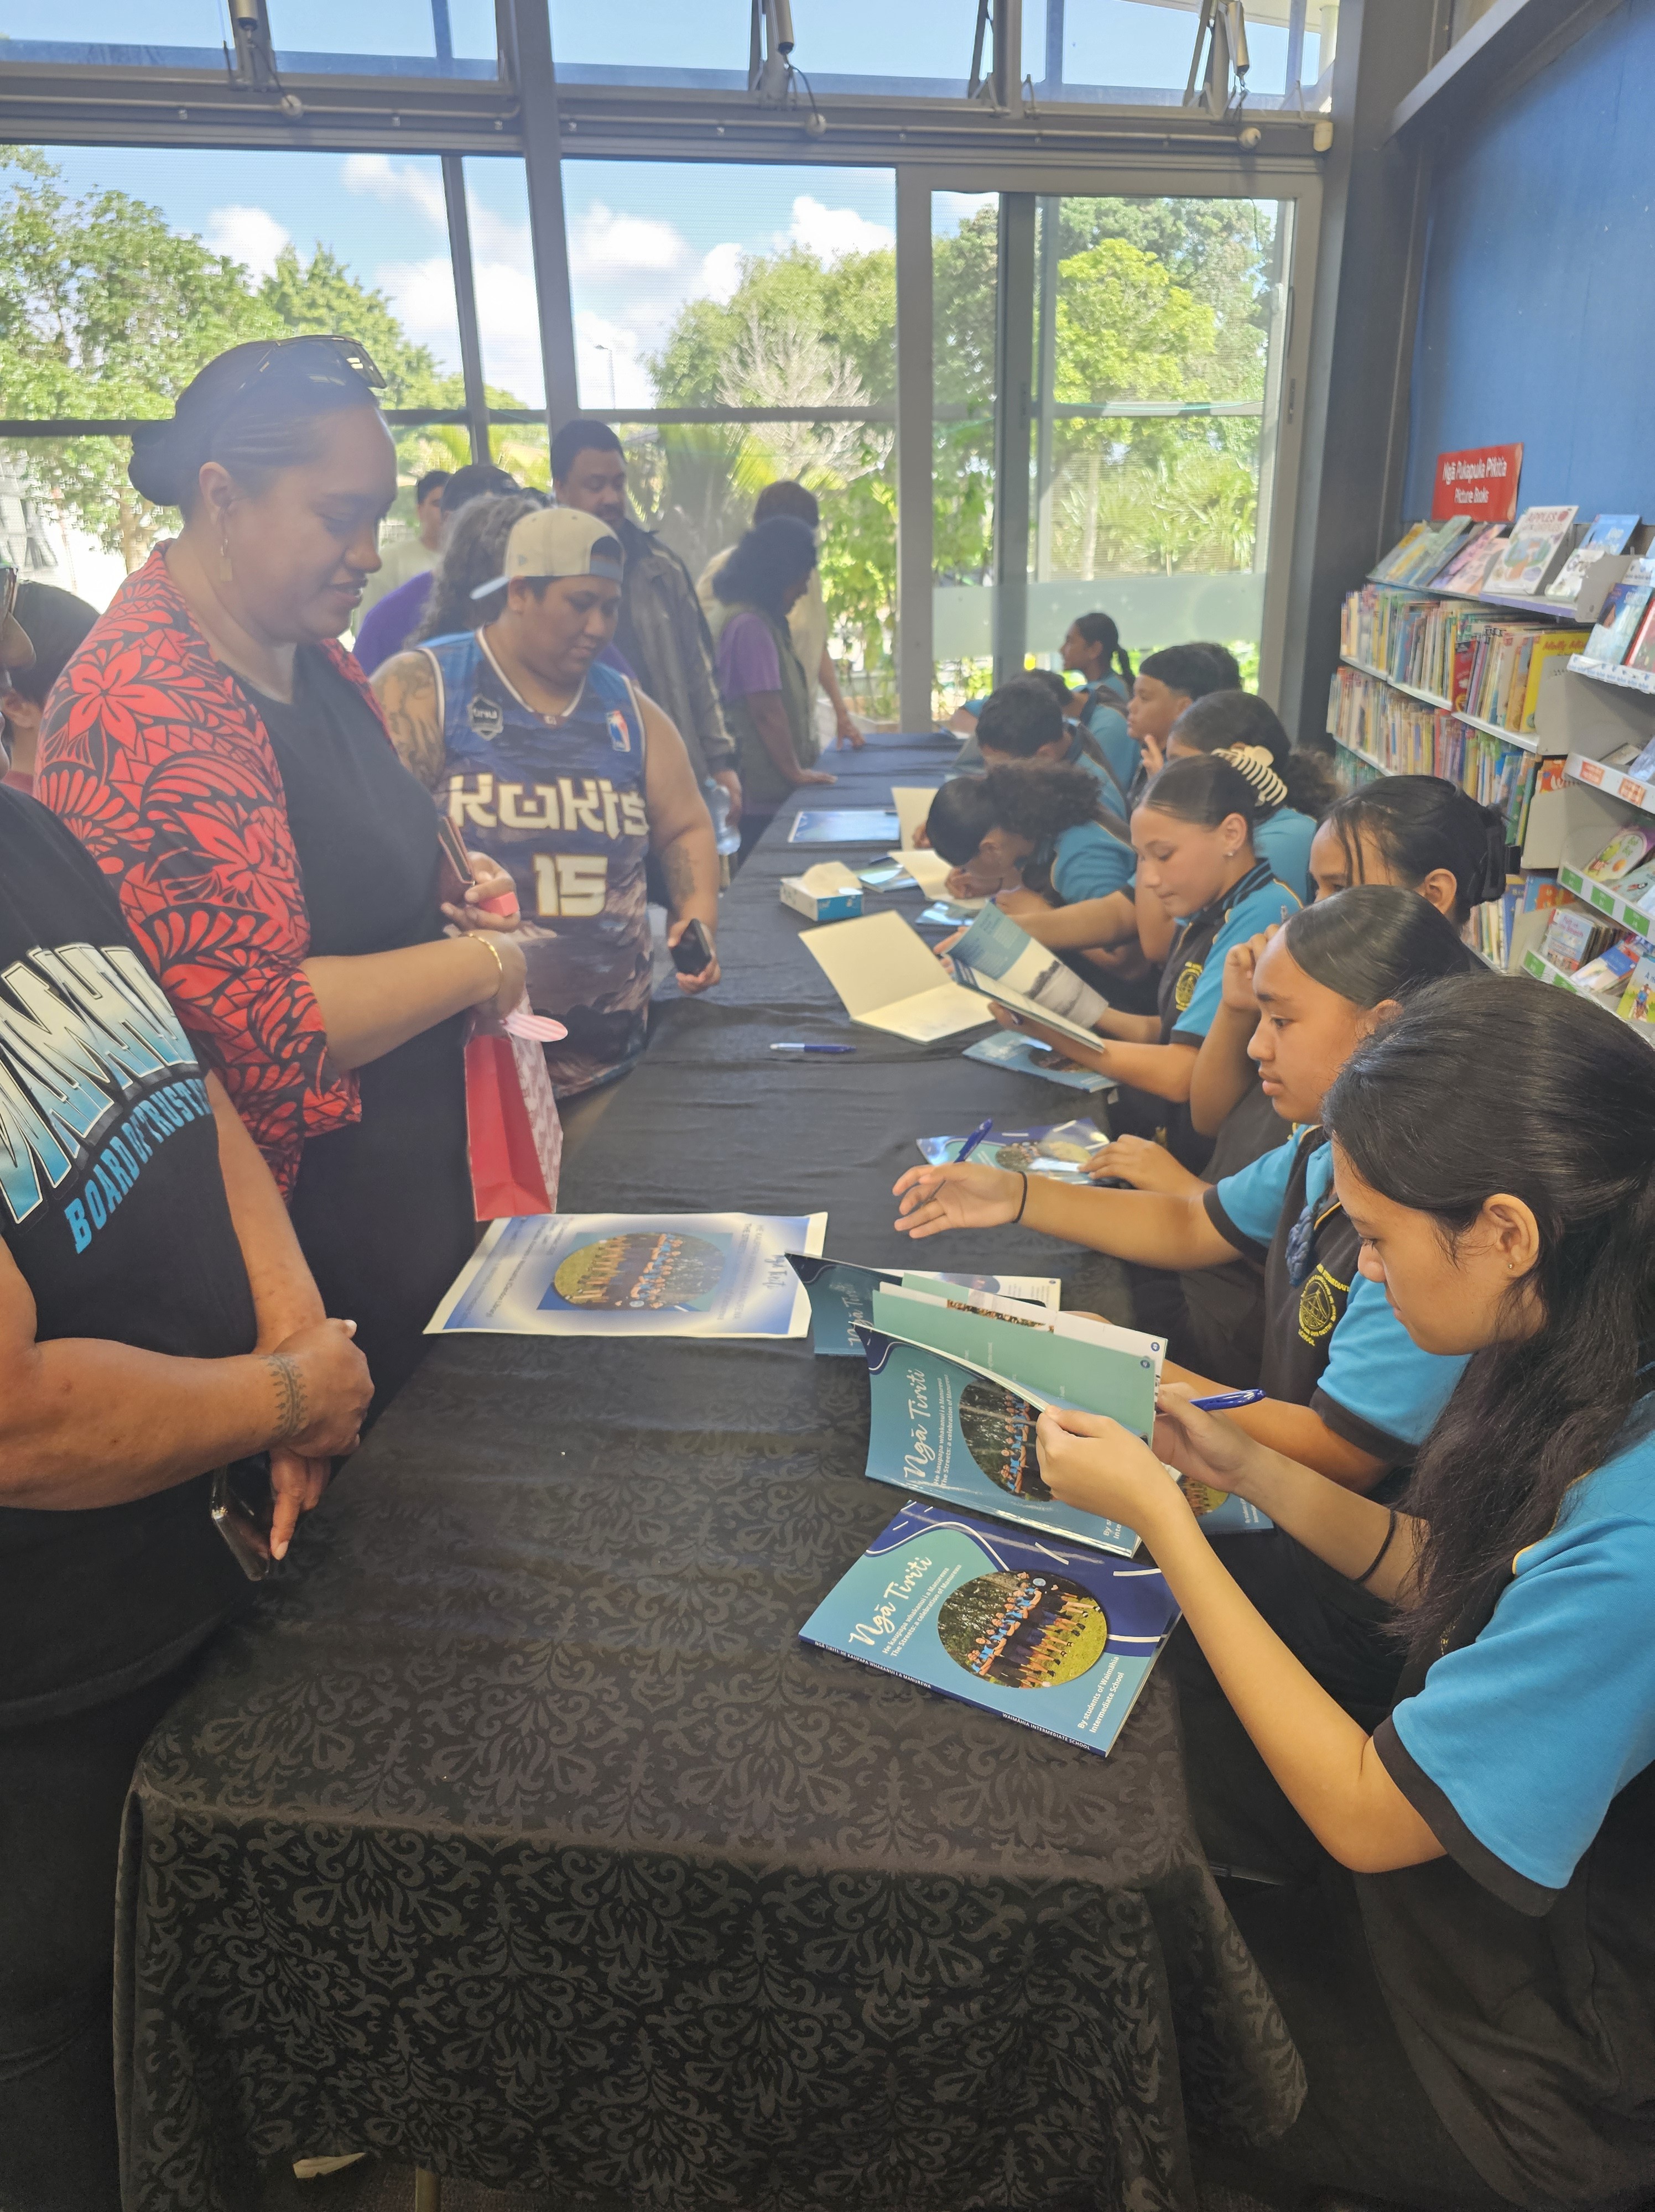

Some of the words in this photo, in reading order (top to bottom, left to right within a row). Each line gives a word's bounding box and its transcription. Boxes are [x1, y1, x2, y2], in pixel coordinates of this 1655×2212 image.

[1454, 487, 1474, 503] Picture
[1474, 486, 1489, 503] Books
[534, 854, 607, 916] 15
[64, 1135, 140, 1254] BOARD
[123, 1115, 153, 1164] OF
[907, 1369, 931, 1420] Tiriti
[903, 1423, 935, 1478] Ngā
[934, 1444, 944, 1474] kaupapa
[943, 1447, 951, 1474] Streets:
[934, 1475, 940, 1485] He
[1103, 1526, 1113, 1536] By
[848, 1602, 896, 1646] Ngā
[883, 1557, 932, 1599] Tiriti
[882, 1644, 891, 1653] He
[889, 1621, 908, 1646] kaupapa
[905, 1597, 926, 1623] whakanui
[928, 1567, 949, 1592] Manurewa
[891, 1644, 902, 1656] The
[899, 1626, 916, 1646] Streets:
[917, 1593, 940, 1621] celebration
[941, 1564, 962, 1589] Manurewa
[847, 1652, 868, 1665] KAUPAPA
[869, 1661, 896, 1675] WHAKANUI
[903, 1674, 931, 1688] MANUREWA
[1100, 1656, 1120, 1686] Waimāhia
[1083, 1692, 1101, 1720] students
[1089, 1693, 1114, 1733] Intermediate
[1110, 1672, 1125, 1692] School
[1097, 1684, 1105, 1693] of
[1002, 1713, 1029, 1727] WAIMĀHIA
[1031, 1724, 1068, 1741] INTERMEDIATE
[1069, 1738, 1090, 1750] SCHOOL
[1078, 1720, 1088, 1729] By
